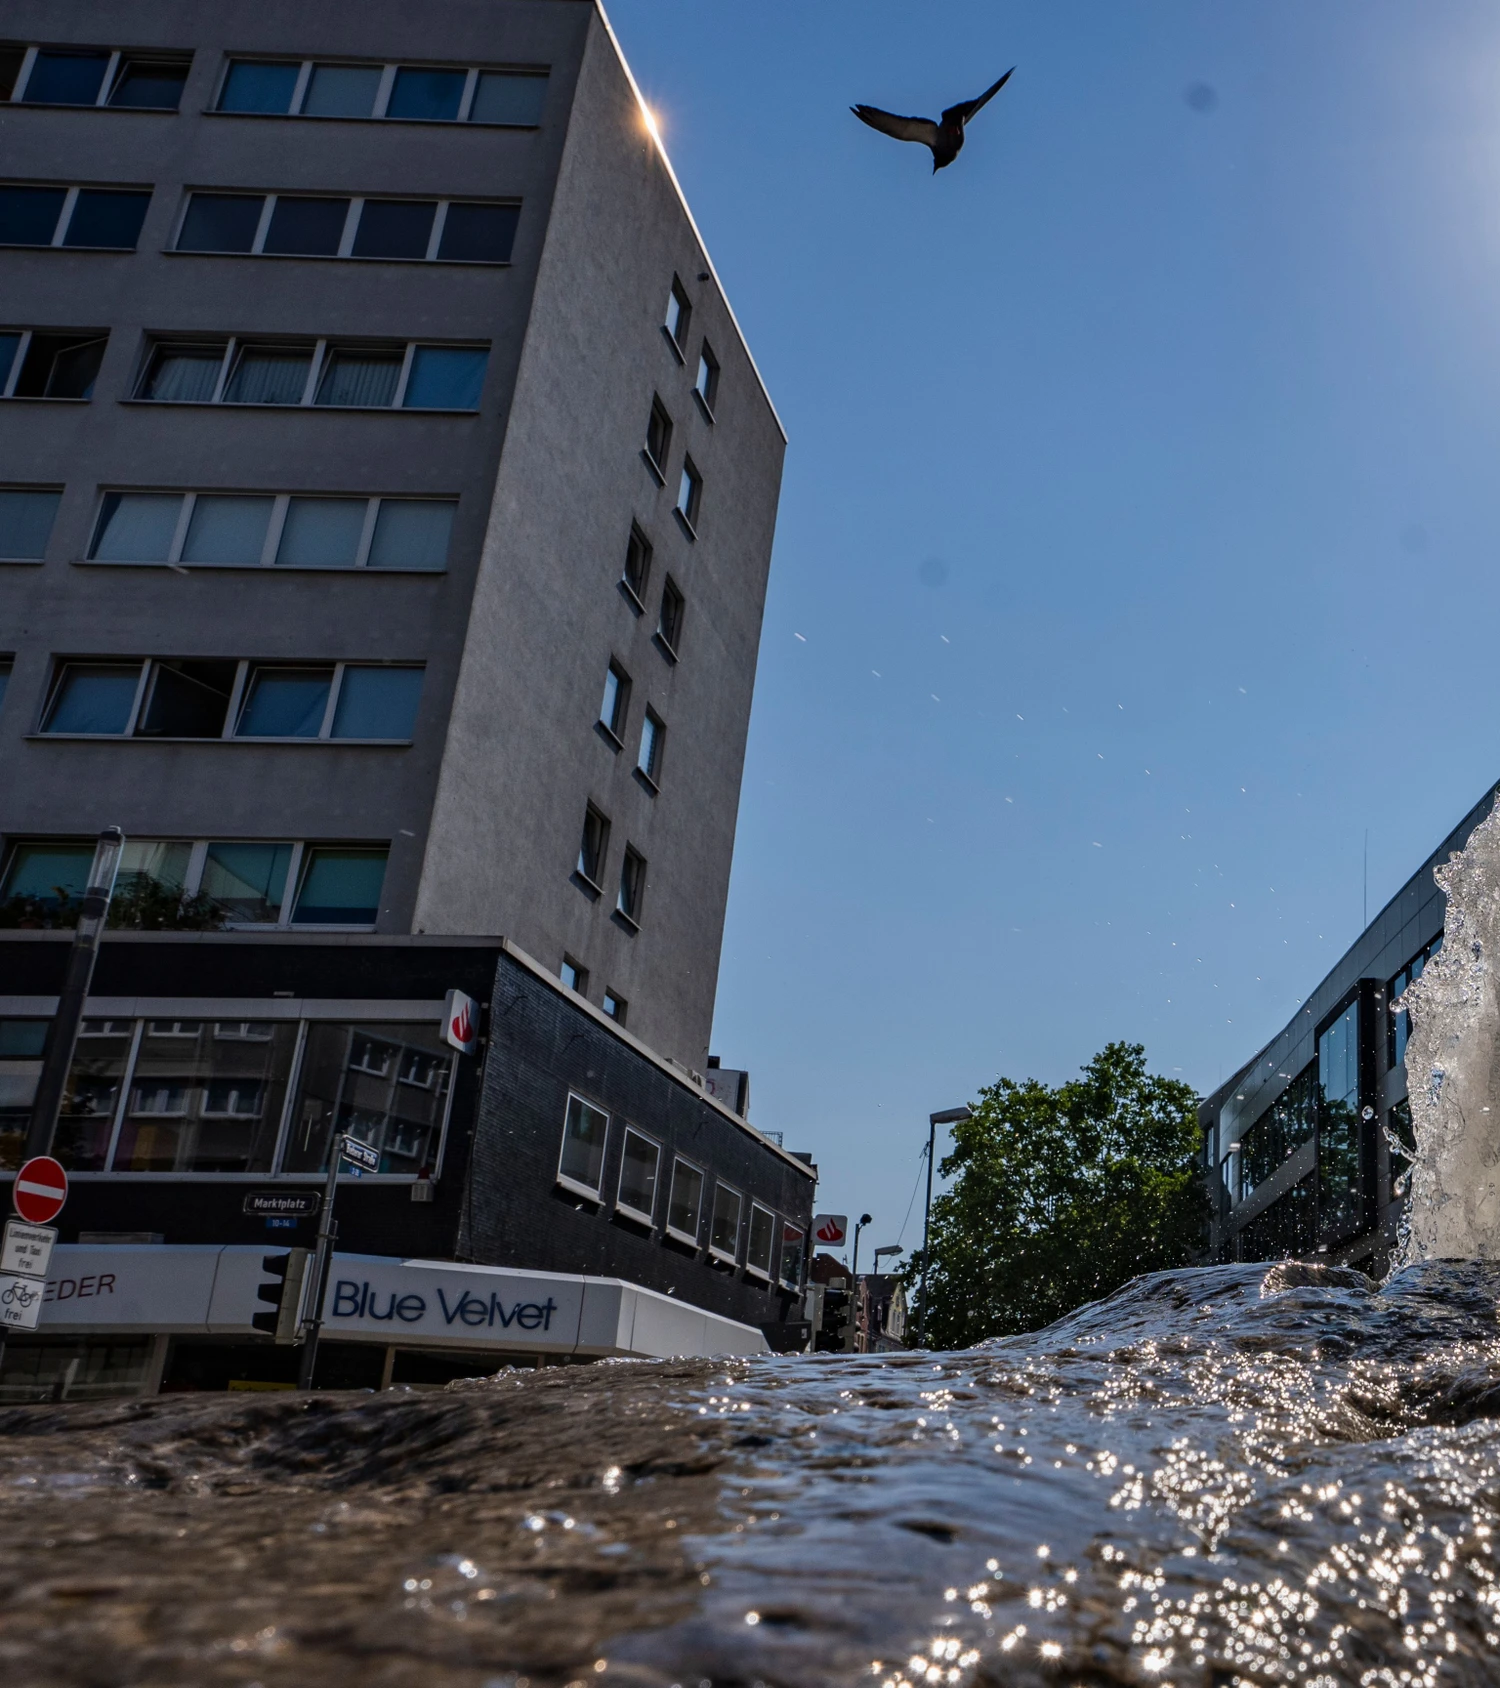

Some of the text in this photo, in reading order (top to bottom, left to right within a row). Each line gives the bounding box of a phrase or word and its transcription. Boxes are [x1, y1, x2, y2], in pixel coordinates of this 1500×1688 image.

[253, 1197, 306, 1211] Marktplatz
[331, 1280, 558, 1331] Blue Velvet
[4, 1308, 23, 1321] frei
